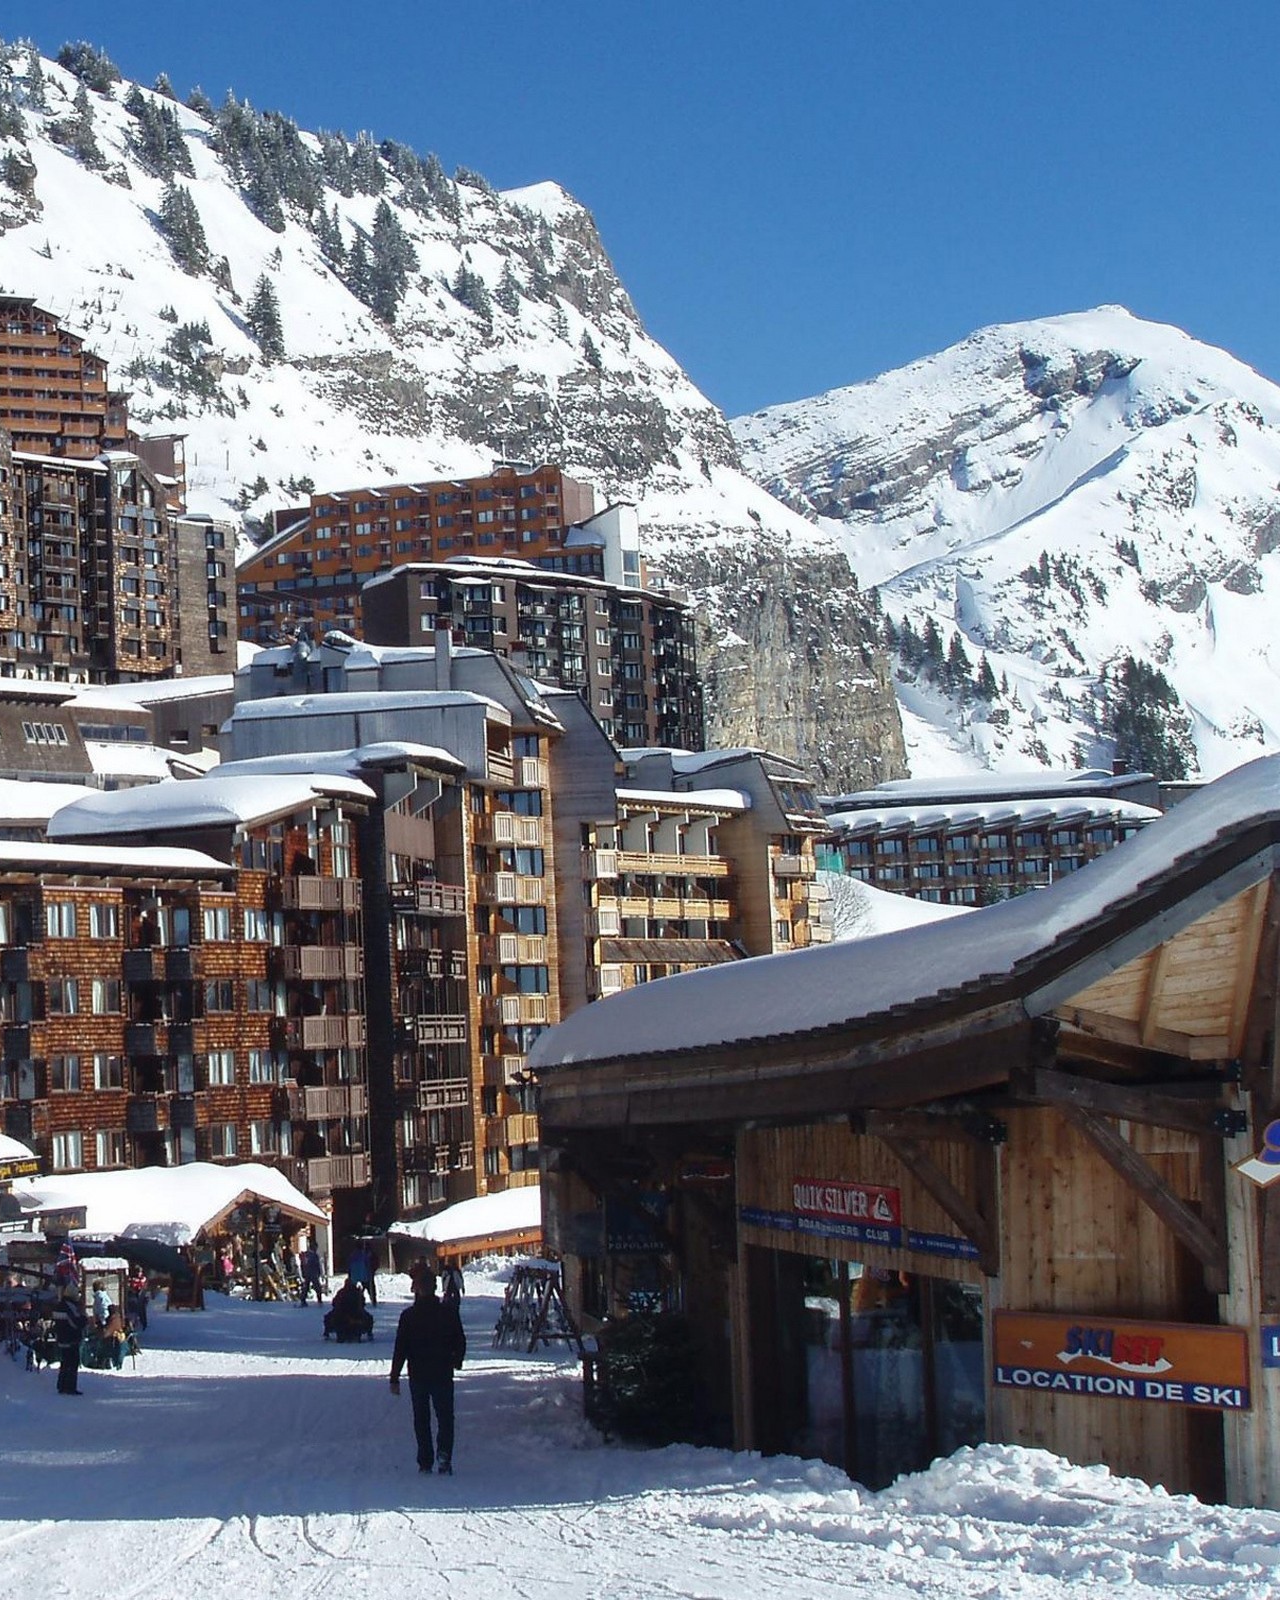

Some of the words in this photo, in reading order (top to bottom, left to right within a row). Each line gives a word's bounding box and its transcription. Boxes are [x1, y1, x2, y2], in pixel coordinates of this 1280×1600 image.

[793, 1183, 869, 1219] QUIKSILVER
[865, 1228, 890, 1242] CLUB
[996, 1367, 1135, 1396] LOCATION
[1145, 1382, 1184, 1401] DE
[1192, 1386, 1242, 1406] SKI
